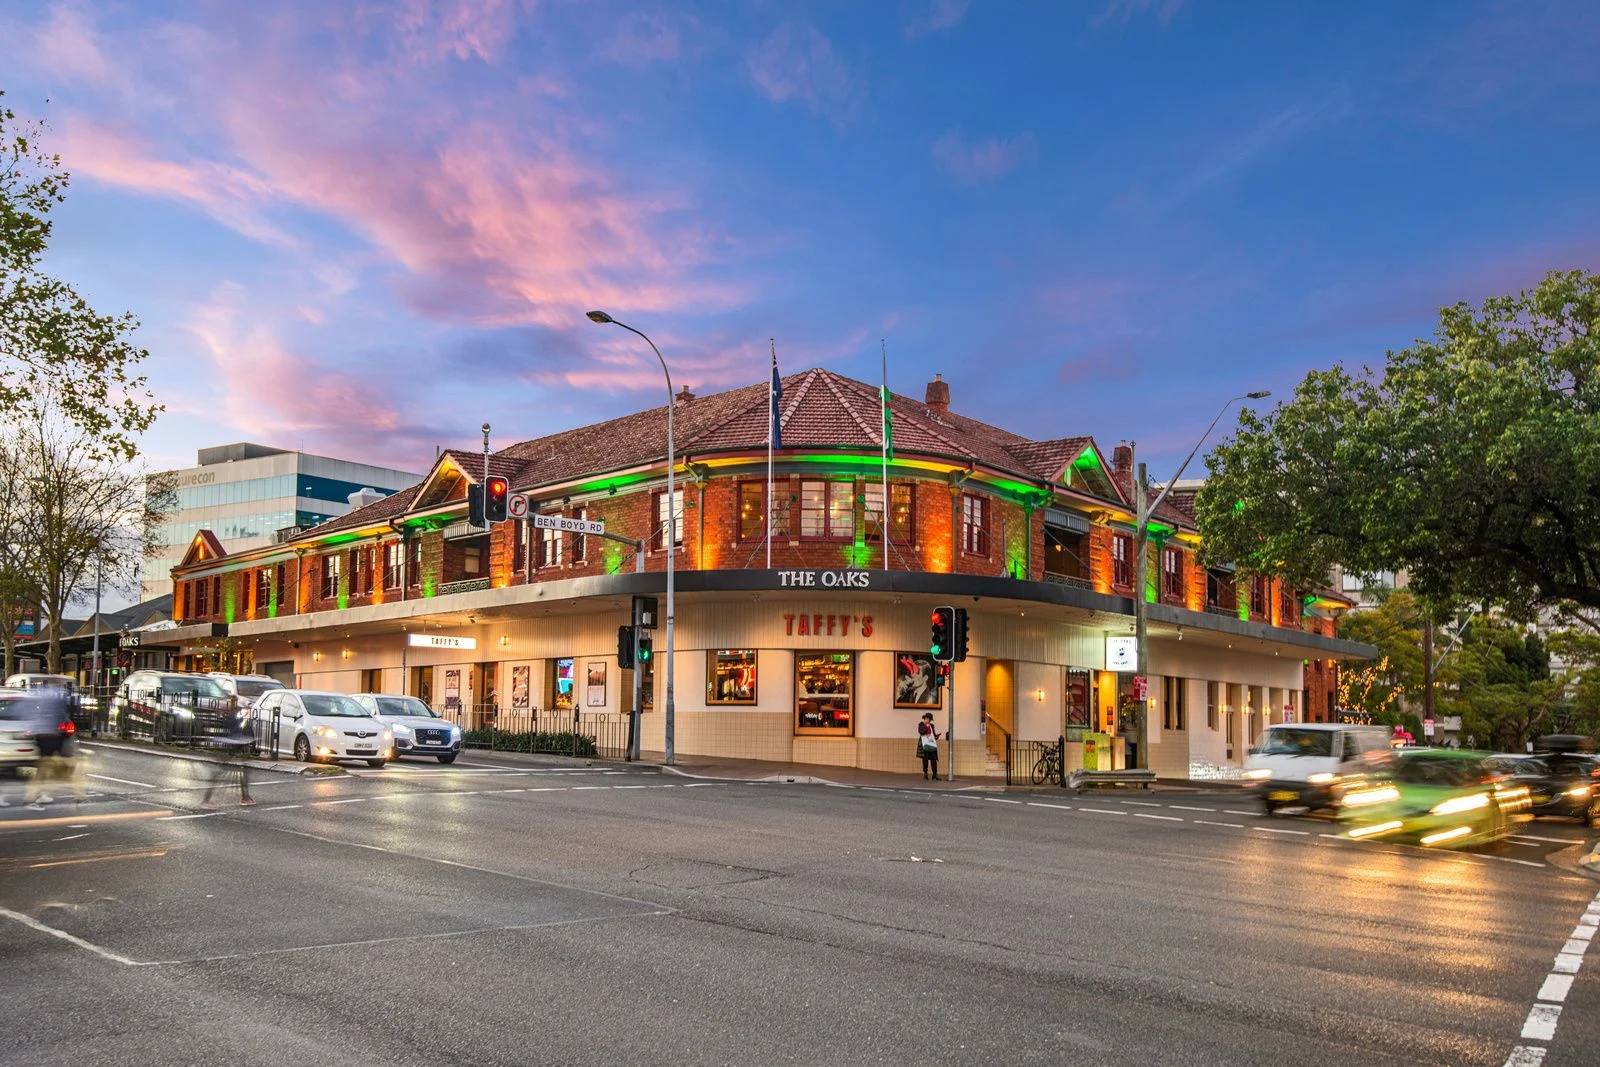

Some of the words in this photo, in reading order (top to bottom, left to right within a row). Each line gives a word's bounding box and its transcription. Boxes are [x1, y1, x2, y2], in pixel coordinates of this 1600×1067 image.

[537, 517, 556, 527] BEN
[560, 520, 586, 531] BOYD
[590, 523, 603, 532] RD
[778, 571, 816, 587] THE
[821, 571, 870, 587] OAKS
[783, 613, 874, 638] TAFFY'S
[431, 637, 459, 646] TAFFY'S
